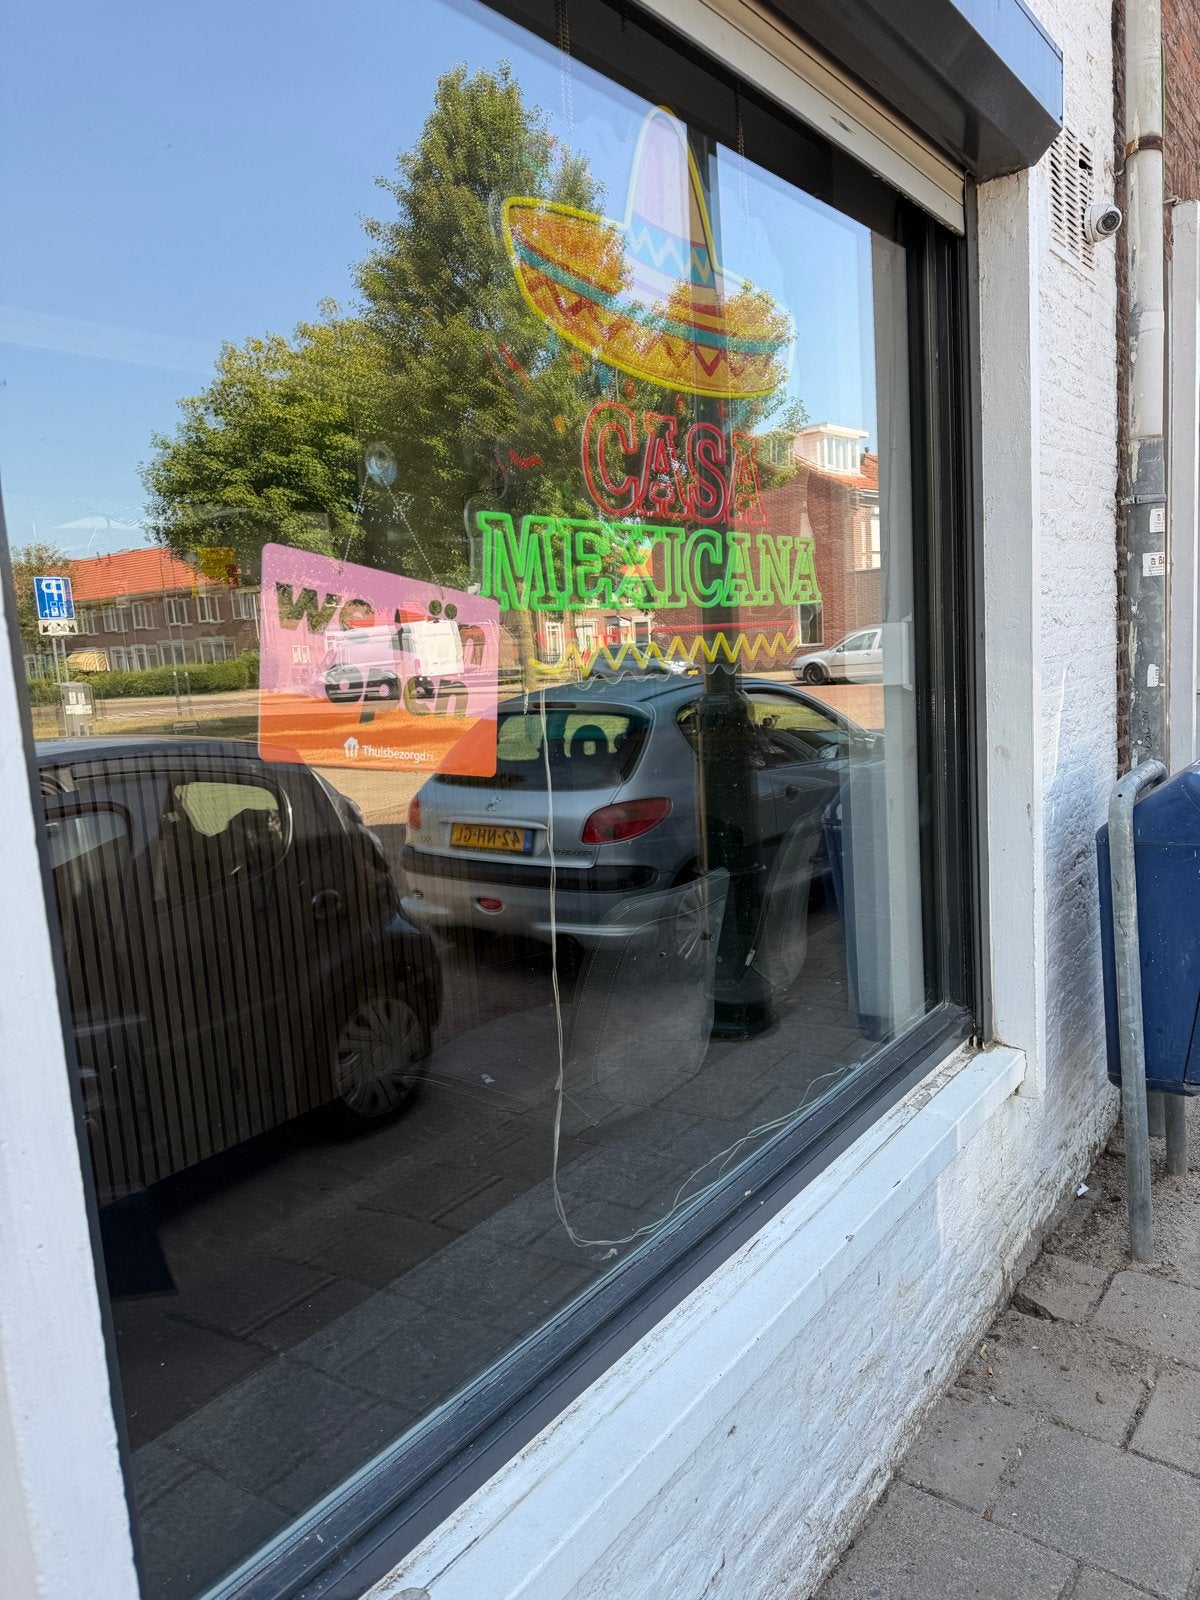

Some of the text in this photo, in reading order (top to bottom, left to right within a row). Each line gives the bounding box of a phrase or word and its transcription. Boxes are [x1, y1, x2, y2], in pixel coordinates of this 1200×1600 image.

[582, 400, 769, 526] CASA
[476, 511, 822, 611] MEXICANA
[275, 581, 375, 644] we
[325, 663, 470, 724] open
